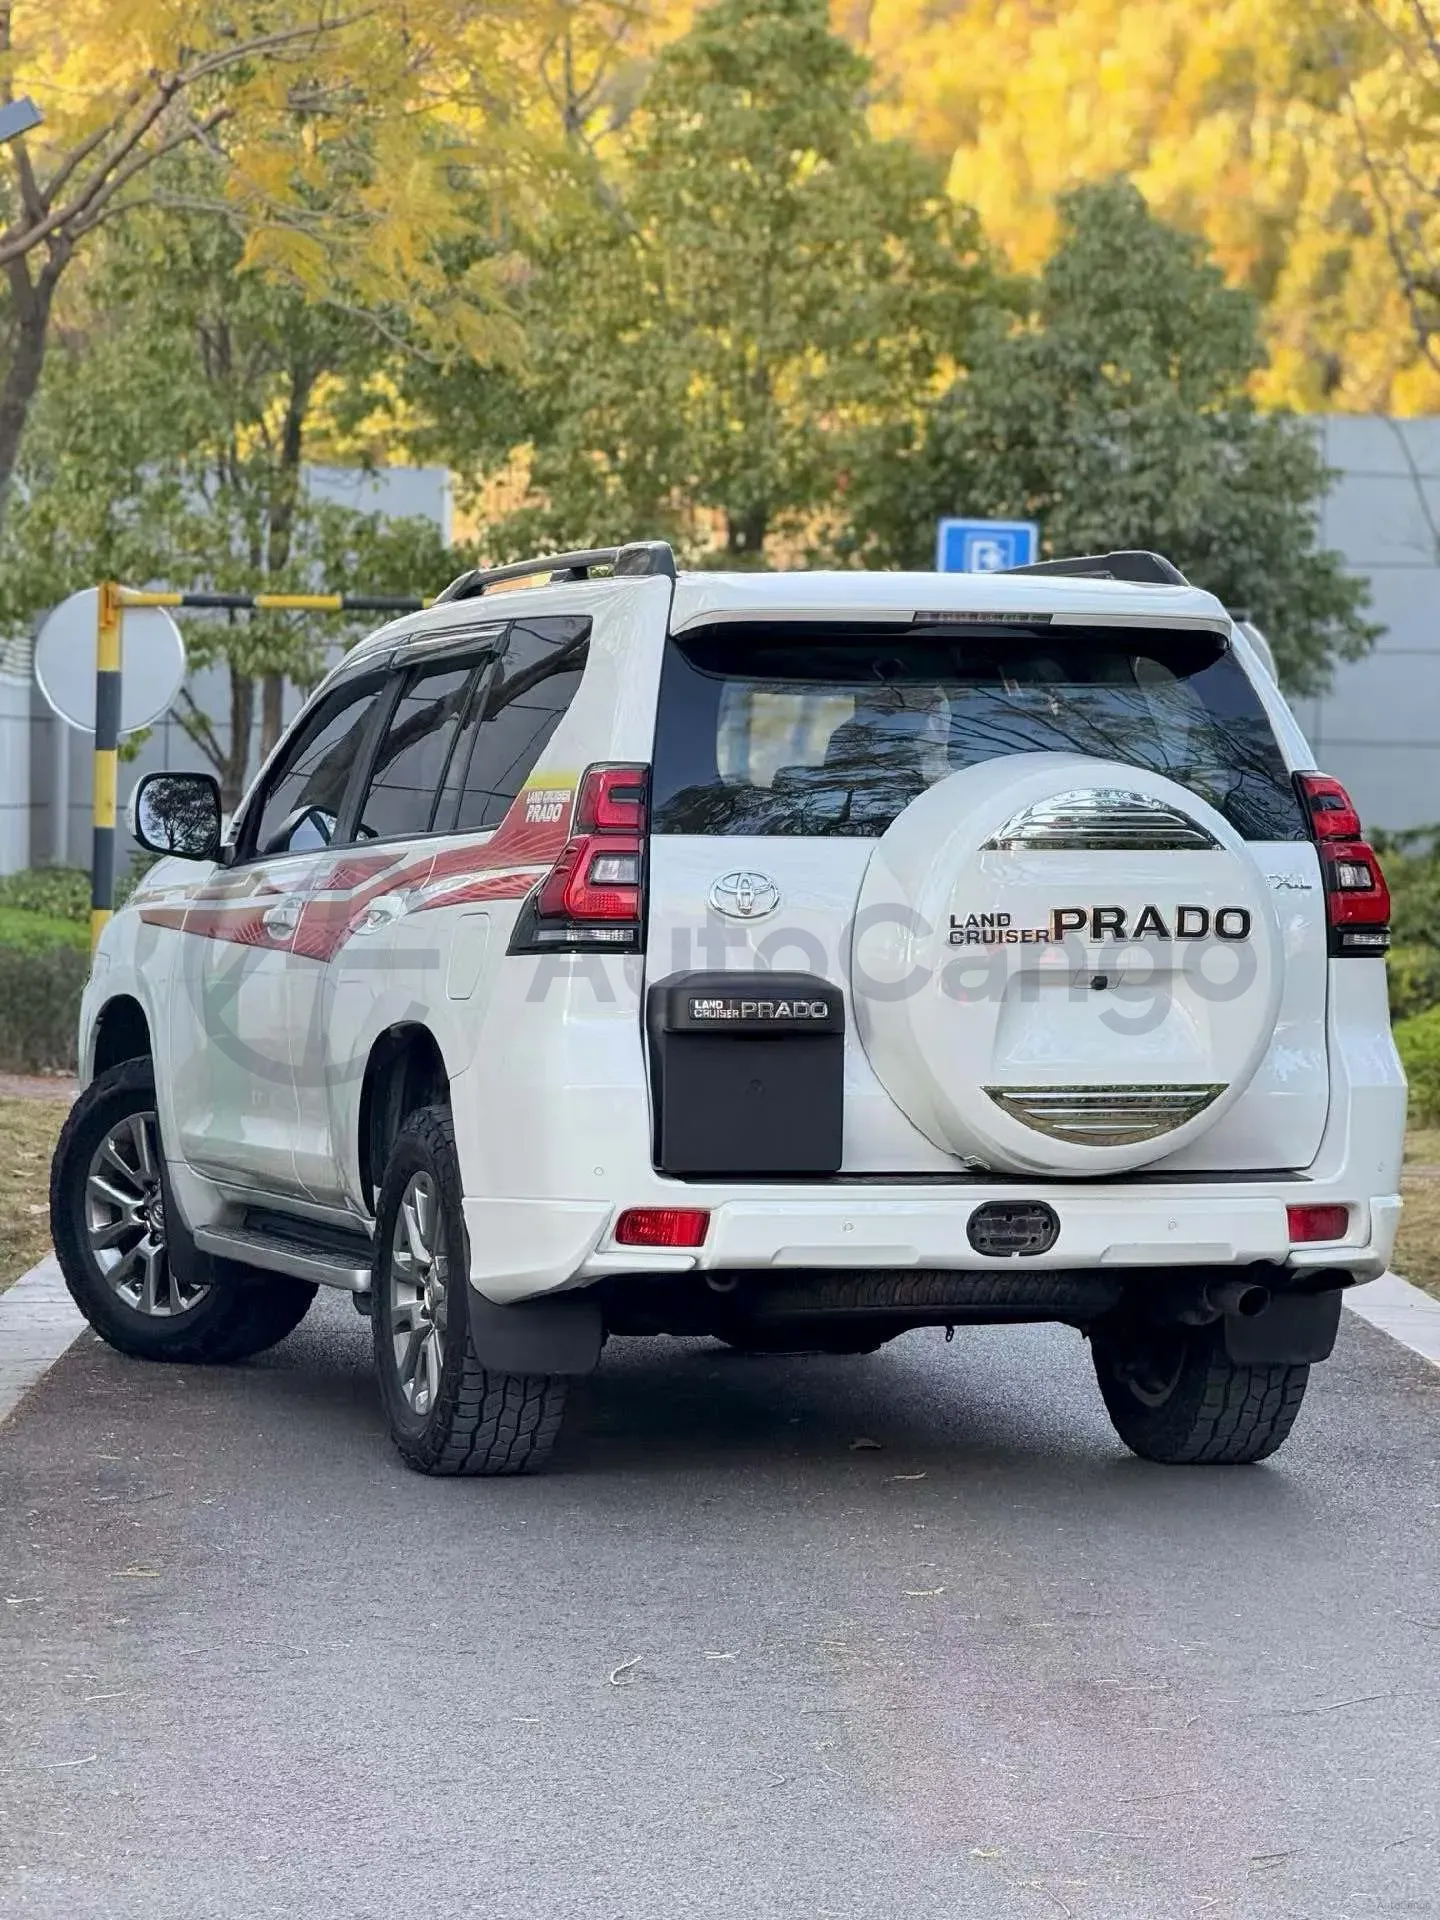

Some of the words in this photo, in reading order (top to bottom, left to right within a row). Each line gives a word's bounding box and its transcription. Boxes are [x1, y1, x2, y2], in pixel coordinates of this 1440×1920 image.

[527, 790, 544, 804] LAND
[525, 803, 563, 823] PRADO
[949, 912, 1011, 929] LAND
[1050, 904, 1252, 944] PRADO
[949, 929, 1051, 945] CRUISER
[694, 1000, 724, 1009] LAND
[741, 1001, 828, 1019] PRADO
[694, 1009, 740, 1019] CRUISER
